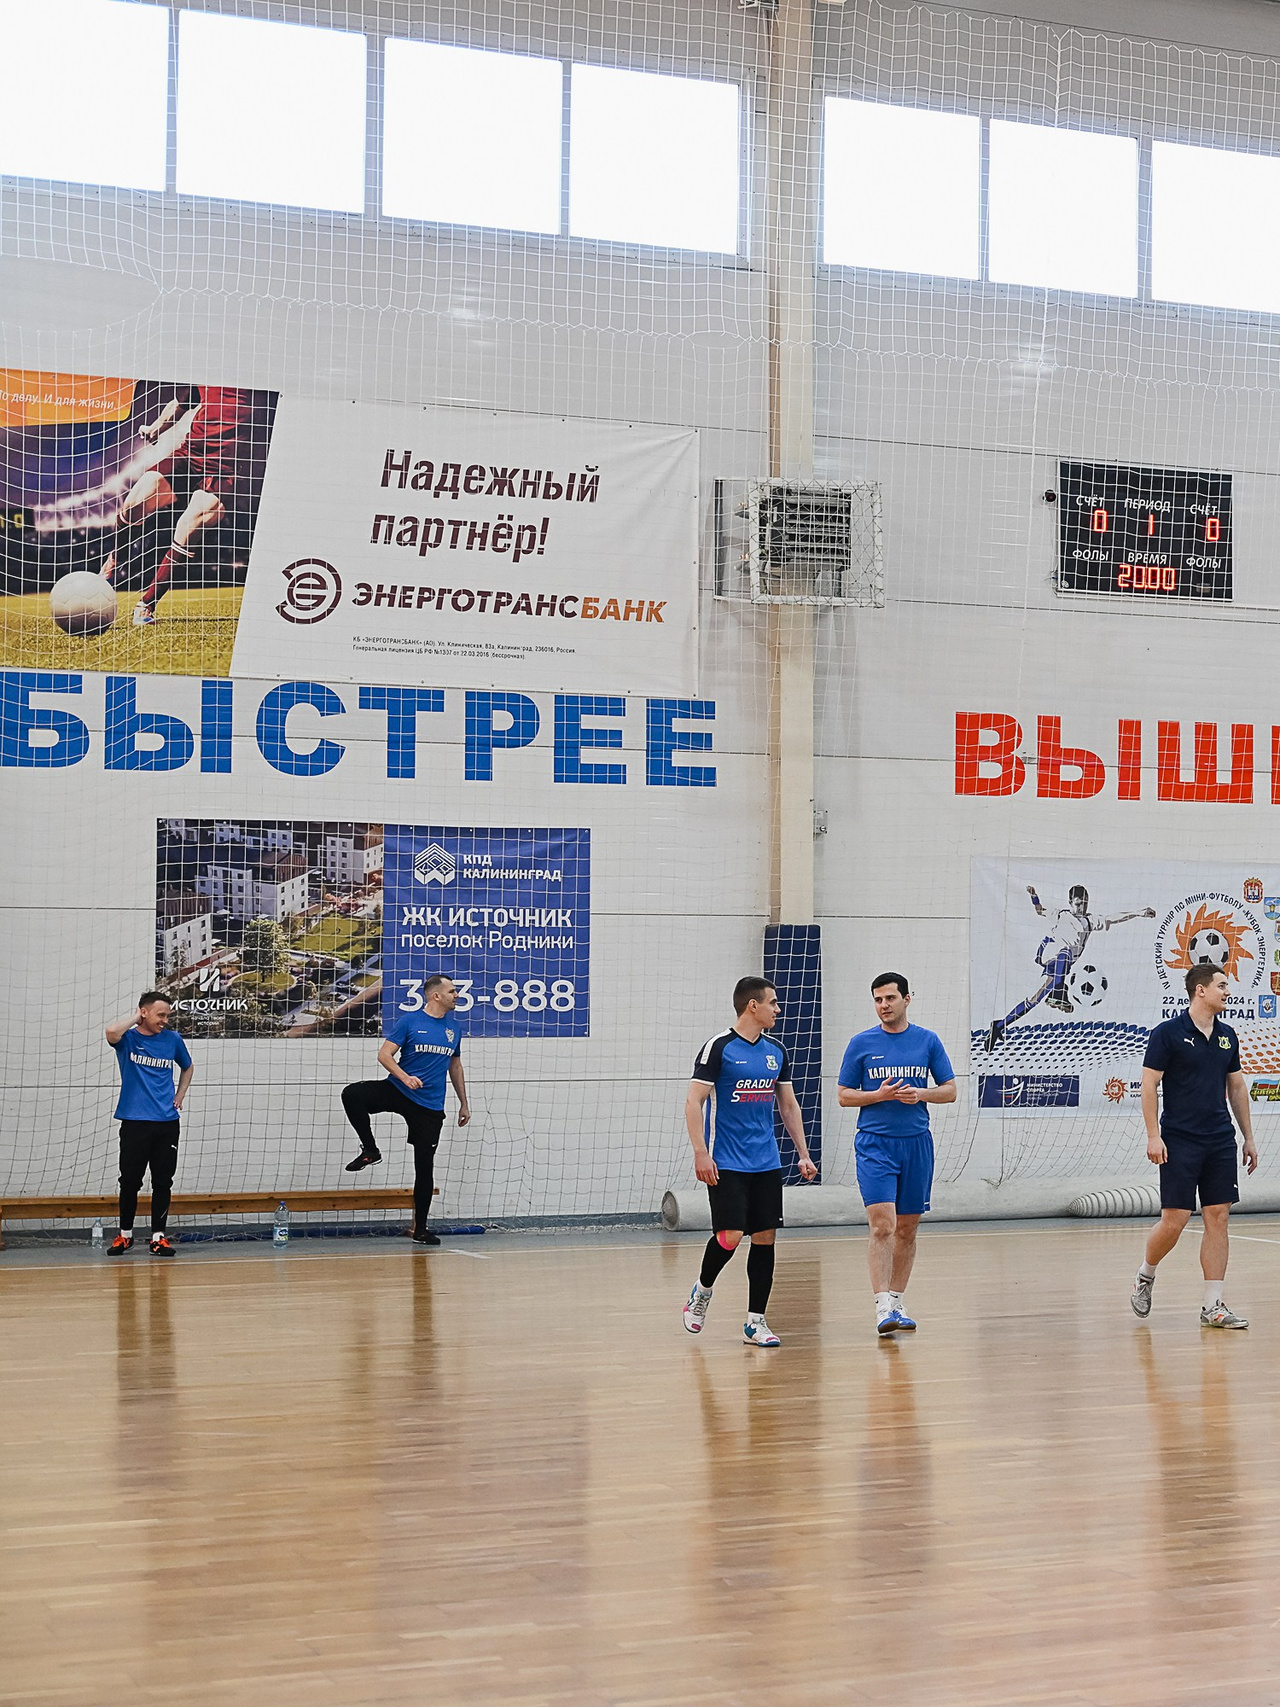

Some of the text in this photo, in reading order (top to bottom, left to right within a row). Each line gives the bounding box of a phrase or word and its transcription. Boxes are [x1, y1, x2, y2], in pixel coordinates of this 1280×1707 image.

[44, 394, 53, 403] И
[55, 396, 75, 406] для
[381, 448, 601, 504] Надежный
[1076, 494, 1218, 515] СЧЁТ ПЕРИОД СЧЁТ
[1093, 510, 1220, 541] 0 1 0
[370, 512, 550, 563] партнёр!
[1072, 549, 1222, 569] ФОЛЫ ВРЕМЯ ФОЛЫ
[352, 582, 667, 625] ЭНЕРГОТРАНСБАНК
[0, 671, 717, 787] БЫСТРЕЕ
[463, 854, 492, 867] КПД
[463, 868, 562, 882] КАЛИНИНГРАД
[1185, 892, 1244, 910] МИНИ-ФУТБОЛУ
[402, 906, 573, 928] ЖК ИСТОЧНИК
[1156, 910, 1175, 940] ТУРНИР
[401, 930, 574, 951] поселок Родники
[1154, 942, 1168, 980] ДЕТСКИЙ
[398, 979, 576, 1012] 33-888
[1162, 996, 1175, 1005] 22
[130, 1051, 172, 1069] АЛИНИНГР
[414, 1043, 455, 1057] КАЛИНИНГР
